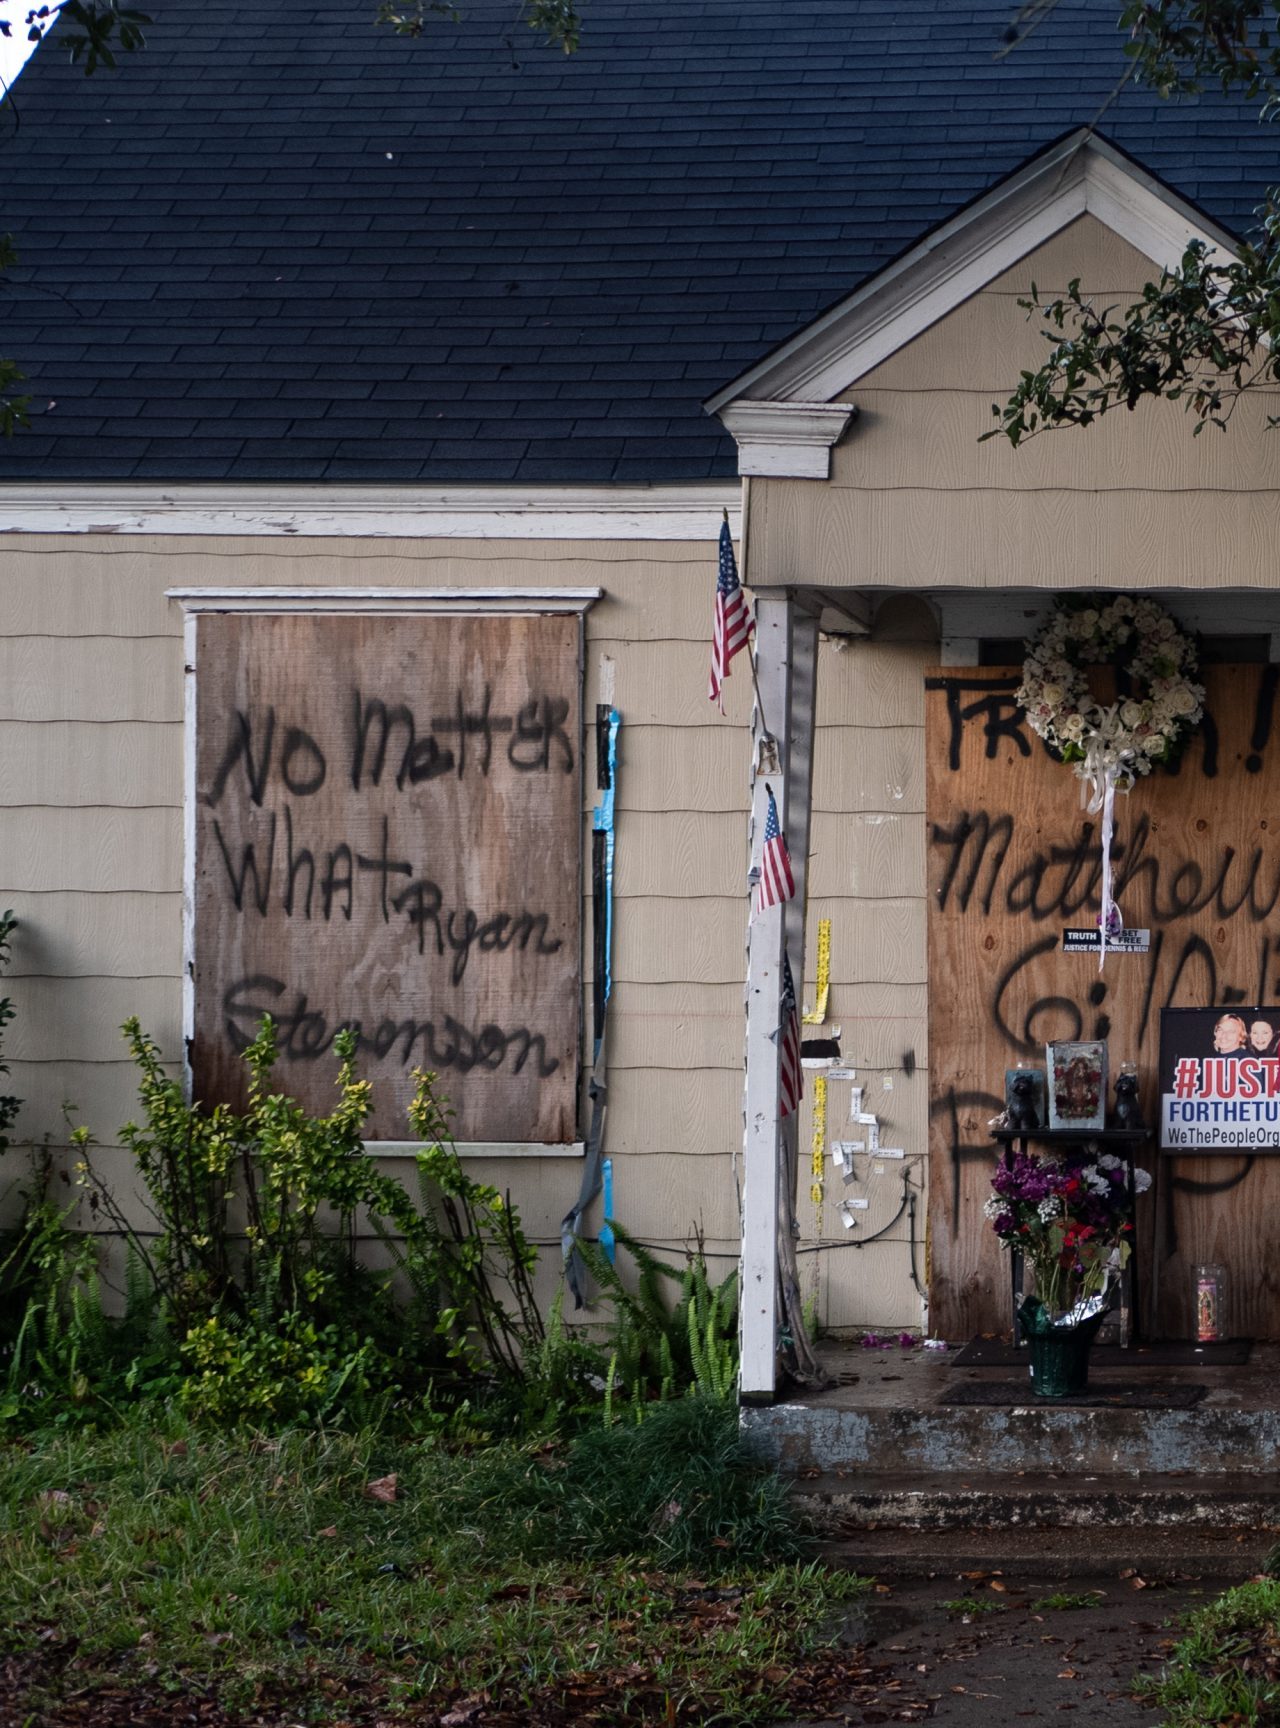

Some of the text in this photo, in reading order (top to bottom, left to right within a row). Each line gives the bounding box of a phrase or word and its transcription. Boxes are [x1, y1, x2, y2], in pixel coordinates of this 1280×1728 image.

[392, 880, 563, 985] Ryan
[1067, 931, 1097, 941] TRUTH
[1118, 936, 1142, 944] FREE
[1063, 944, 1088, 952] JUSTICE
[1088, 944, 1102, 952] FOR
